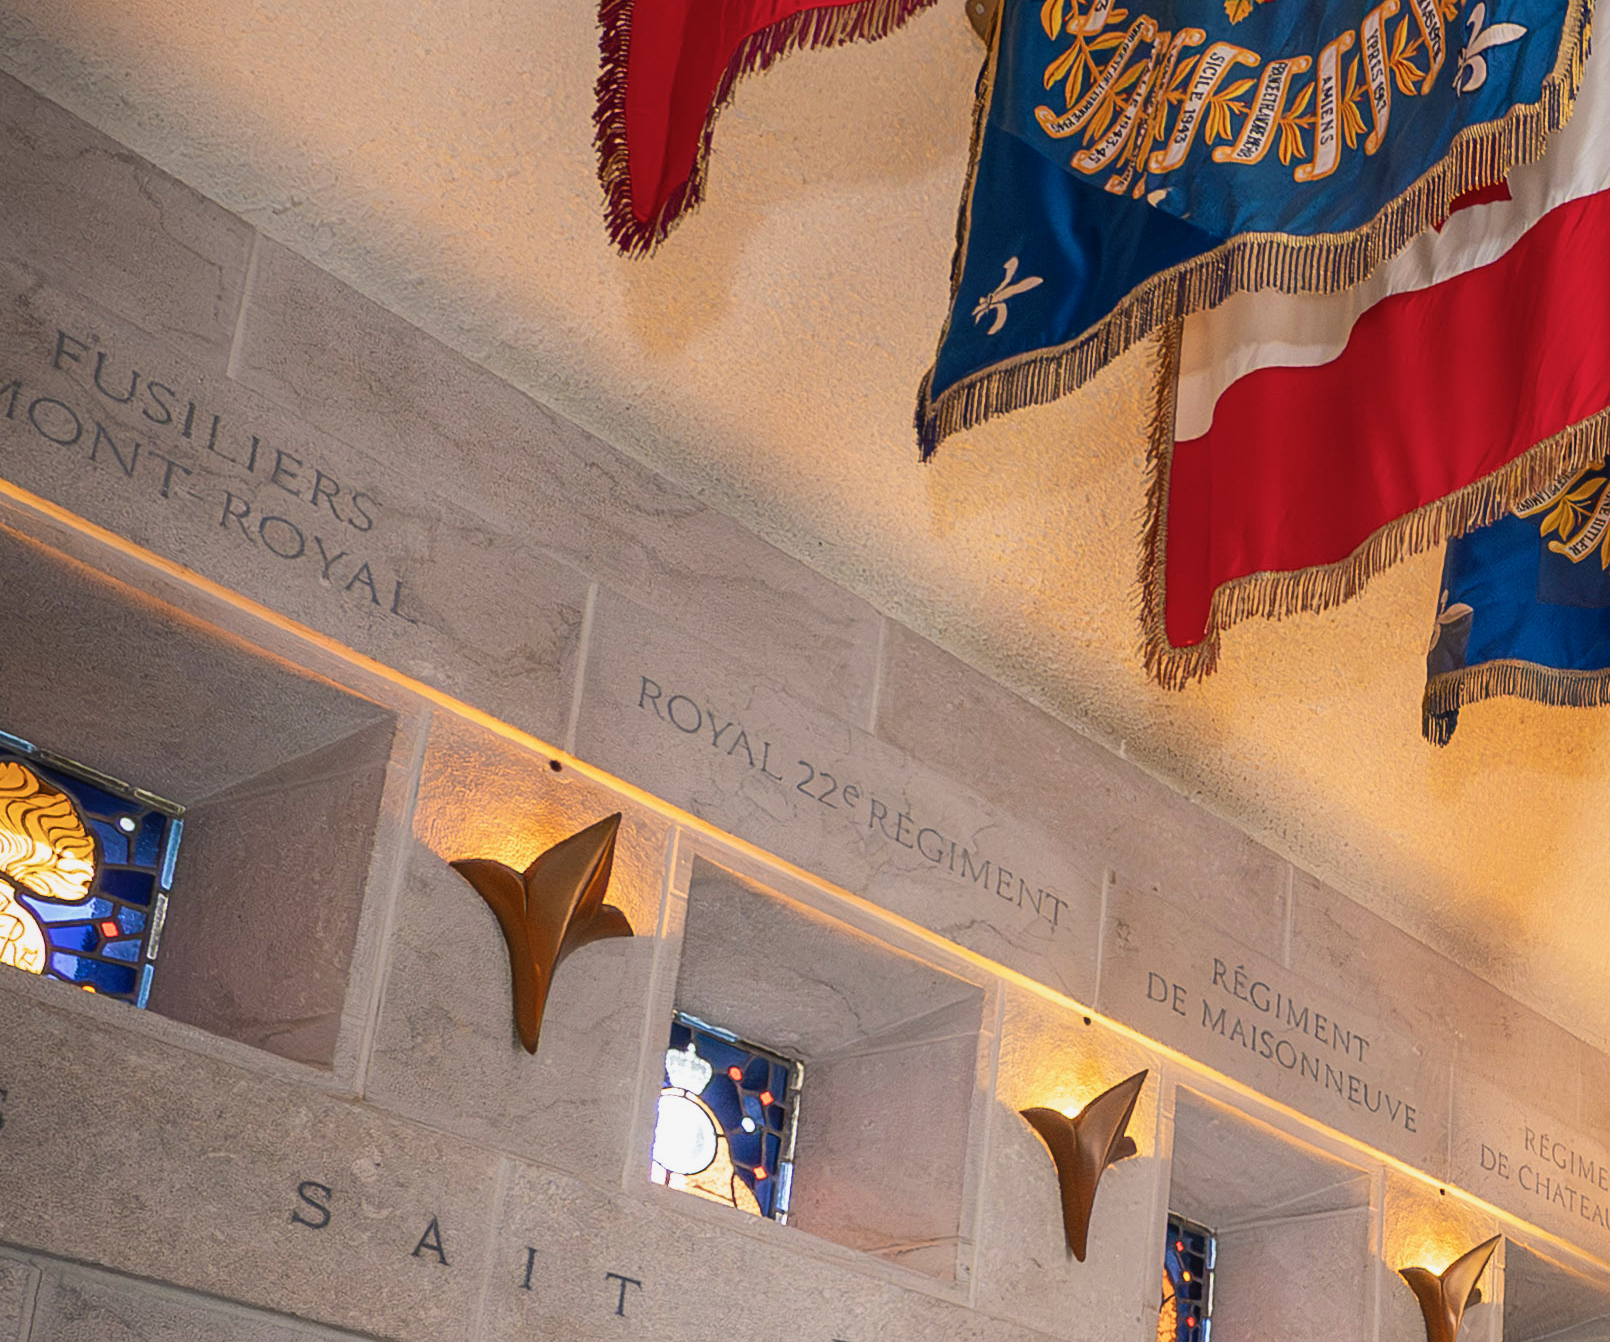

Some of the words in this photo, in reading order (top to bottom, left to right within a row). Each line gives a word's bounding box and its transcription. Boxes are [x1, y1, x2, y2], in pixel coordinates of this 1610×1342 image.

[1174, 108, 1197, 144] 1943
[1189, 51, 1226, 103] SICILE
[1319, 76, 1335, 146] AMIENS
[52, 329, 383, 533] FUSILIERS
[637, 675, 783, 781] ROYAL
[1146, 971, 1188, 1017] DE
[1201, 999, 1418, 1134] MAISONNEUVE
[1211, 957, 1371, 1063] RÉGIMENT
[1479, 1142, 1511, 1182] DE
[290, 1179, 644, 1318] SAIT
